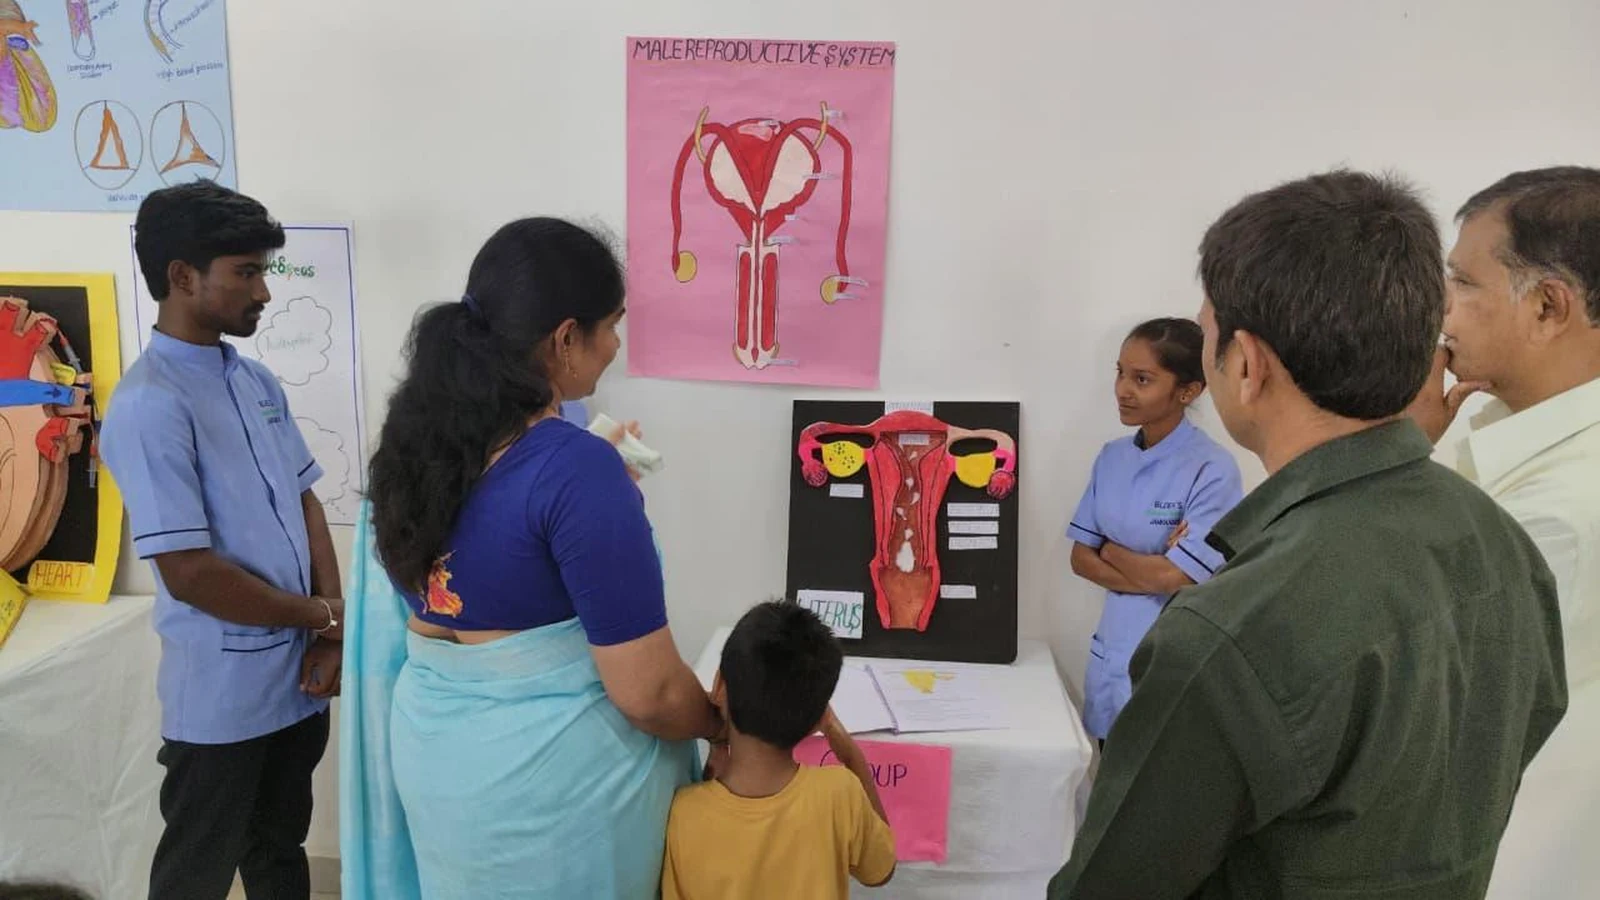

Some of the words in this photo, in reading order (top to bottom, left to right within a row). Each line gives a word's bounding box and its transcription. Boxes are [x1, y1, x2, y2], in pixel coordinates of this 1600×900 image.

[633, 39, 682, 60] MALE
[685, 39, 826, 65] REPRODUCTIVE
[825, 44, 896, 68] SYSTEM
[35, 562, 86, 591] HEART
